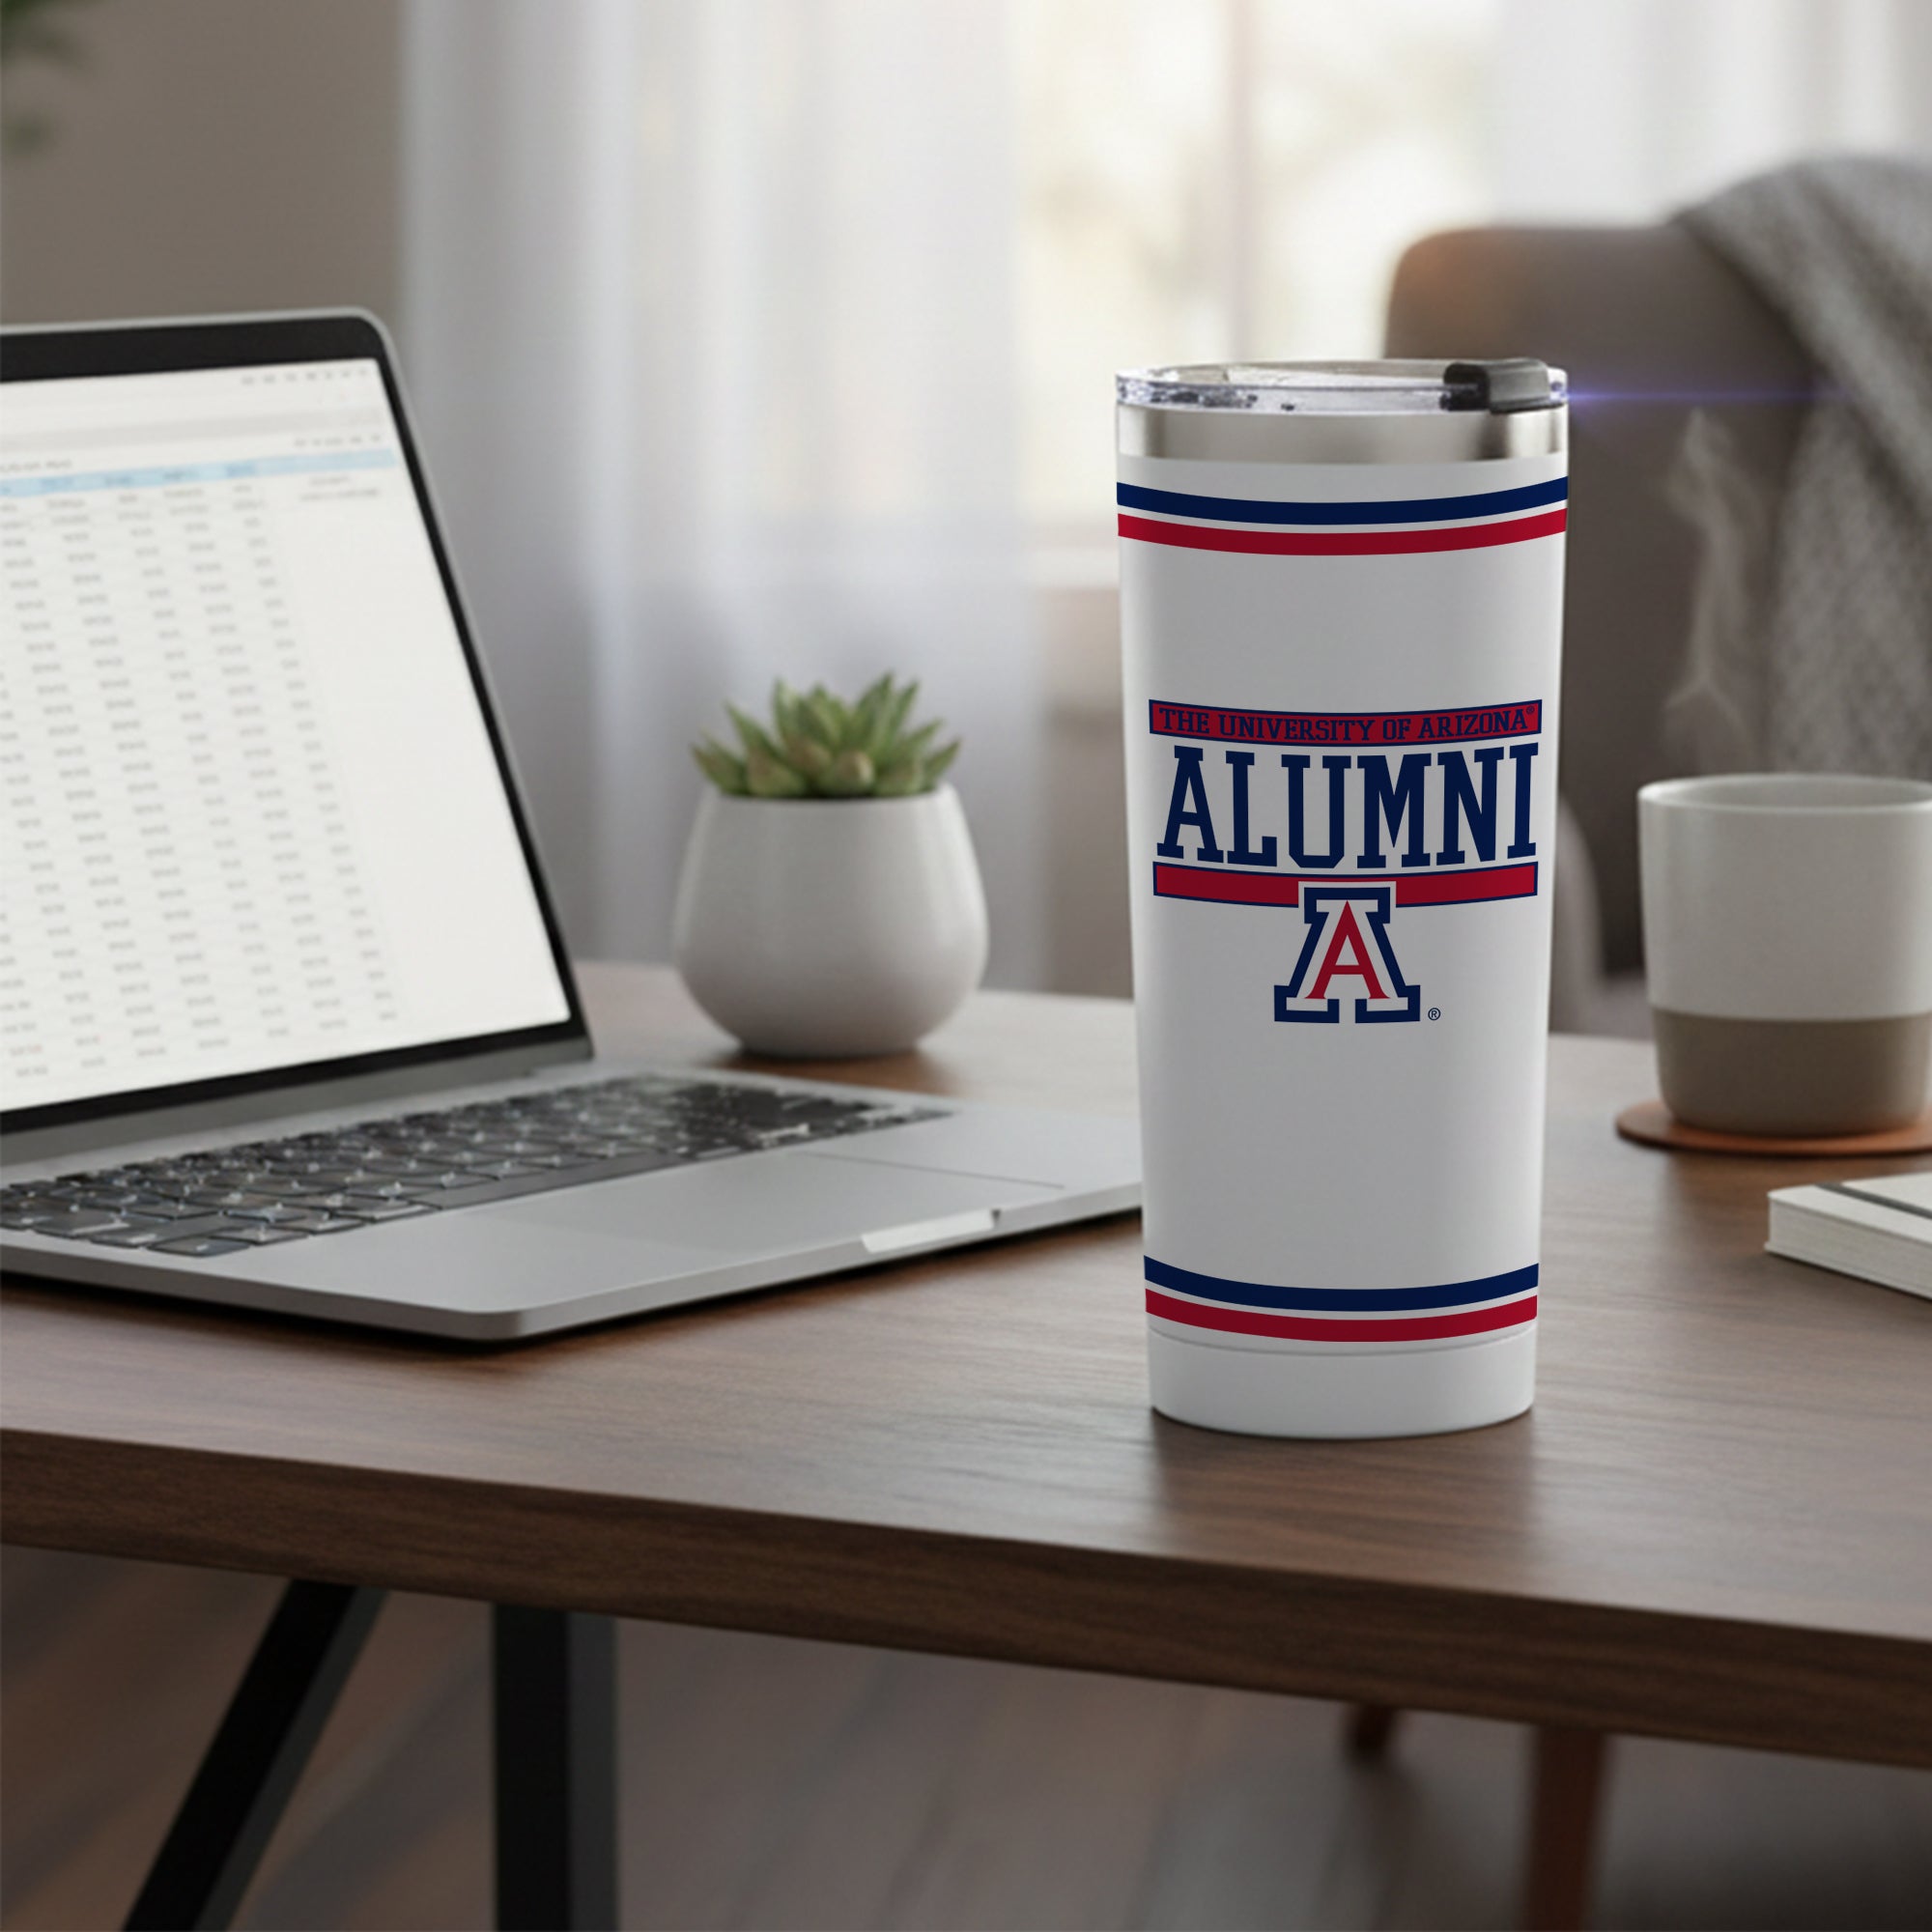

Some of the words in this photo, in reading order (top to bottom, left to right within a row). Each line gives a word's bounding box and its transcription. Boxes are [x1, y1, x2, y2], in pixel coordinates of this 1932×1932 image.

[1159, 707, 1209, 734] THE
[1219, 715, 1374, 742] UNIVERSITY
[1382, 718, 1411, 741] OF
[1156, 743, 1539, 869] ALUMNI
[1274, 887, 1421, 1024] A
